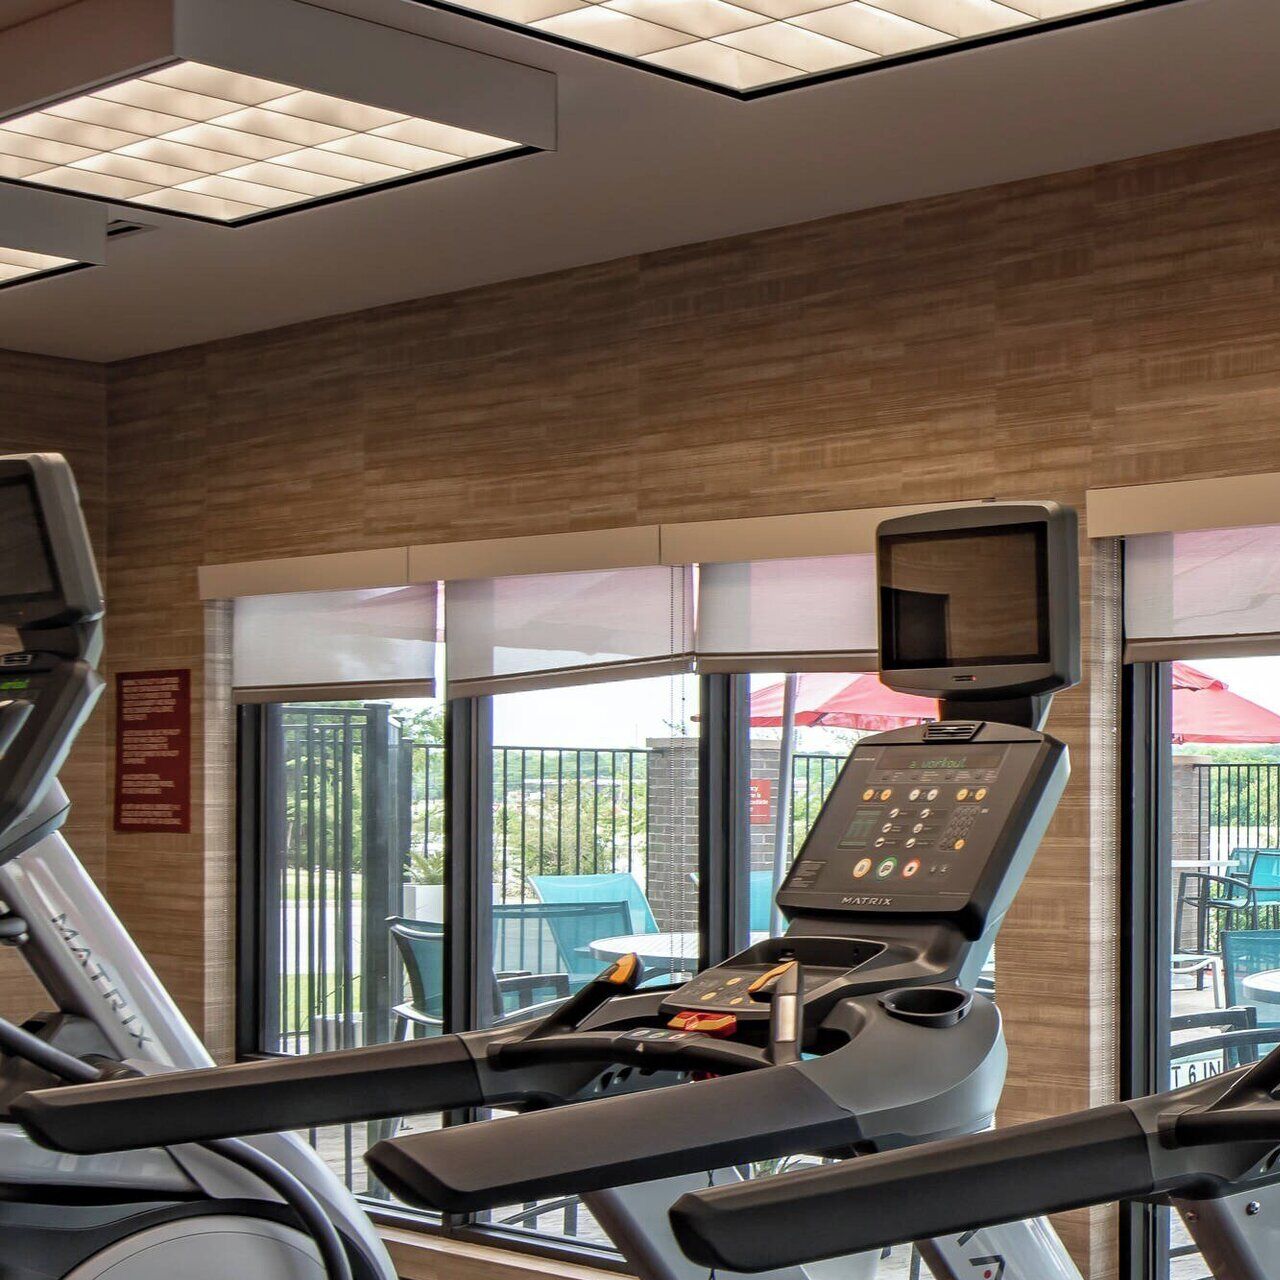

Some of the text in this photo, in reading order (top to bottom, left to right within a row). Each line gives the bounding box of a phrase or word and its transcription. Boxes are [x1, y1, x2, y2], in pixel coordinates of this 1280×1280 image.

[841, 897, 893, 906] MATRIX
[51, 913, 154, 1050] MATRIX
[1188, 1064, 1196, 1084] 6
[1203, 1060, 1221, 1079] IN
